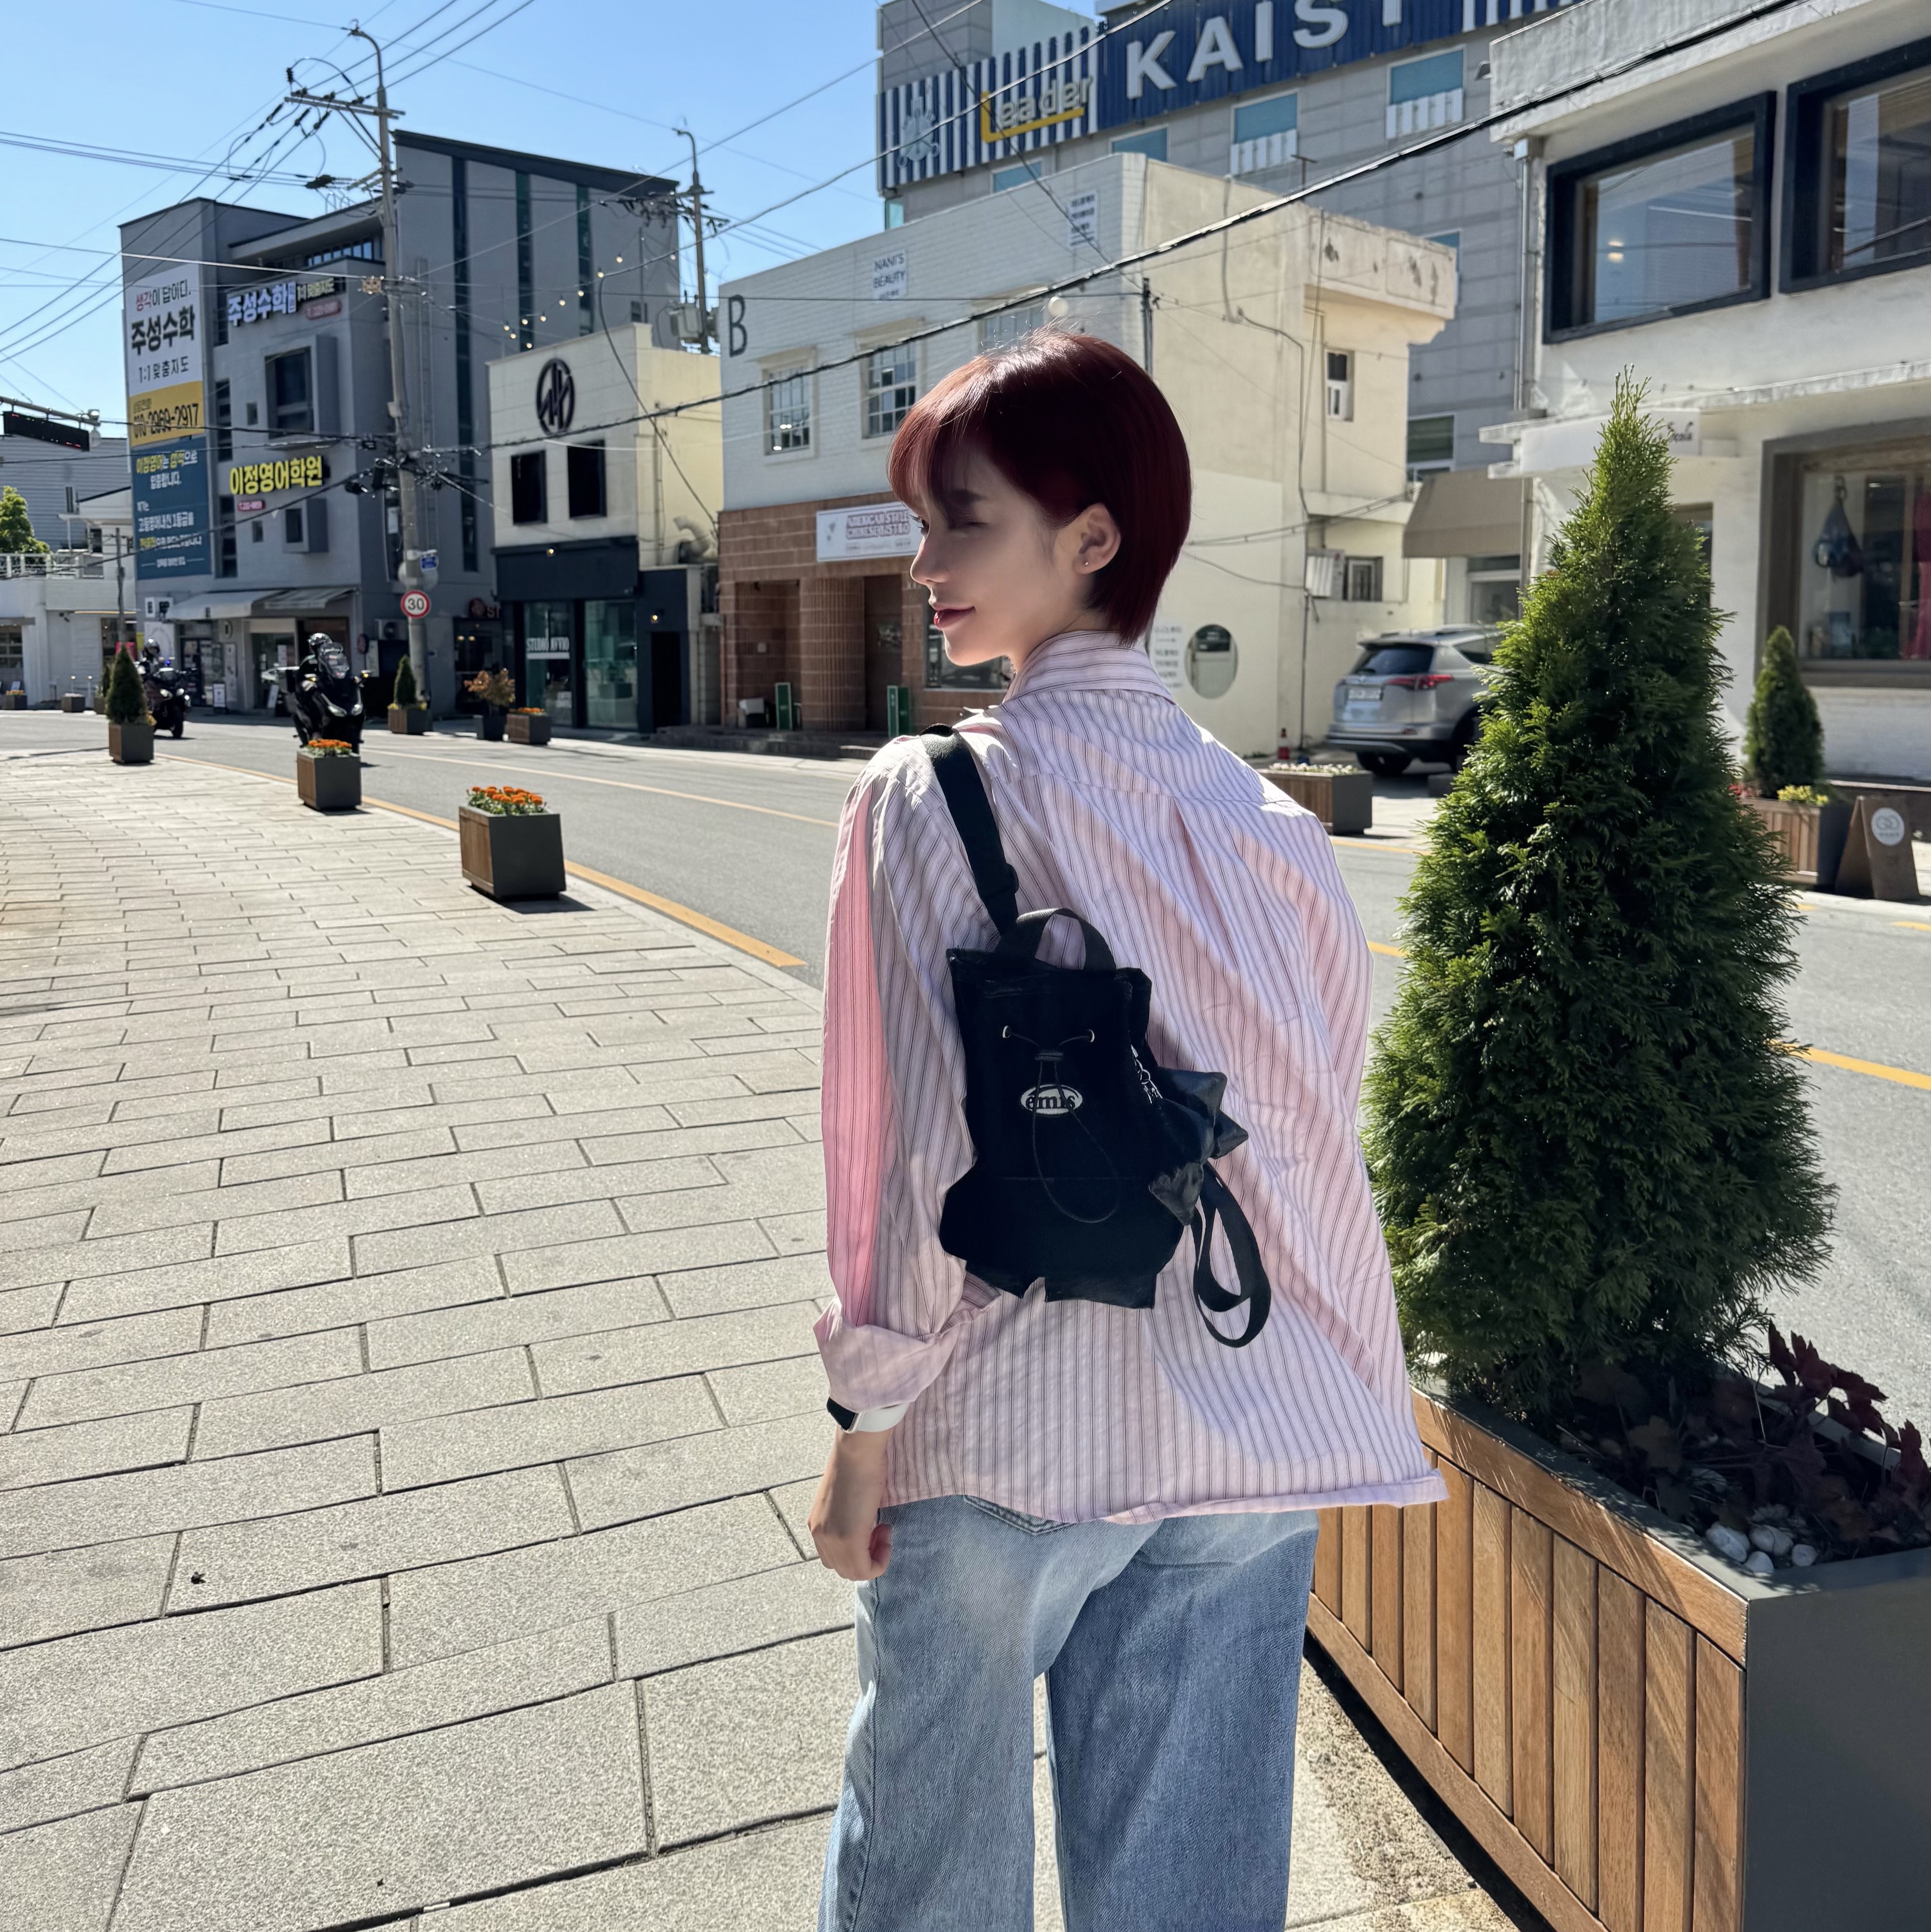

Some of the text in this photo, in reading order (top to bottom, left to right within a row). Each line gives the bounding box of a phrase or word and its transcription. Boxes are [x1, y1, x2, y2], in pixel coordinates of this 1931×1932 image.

[980, 75, 1094, 144] Leader
[136, 279, 191, 311] 생각이 답이다.
[228, 283, 289, 327] 주성수학
[131, 304, 195, 355] 주성수학
[729, 295, 747, 357] B
[230, 456, 323, 494] 이정영어학원
[408, 598, 424, 610] 30
